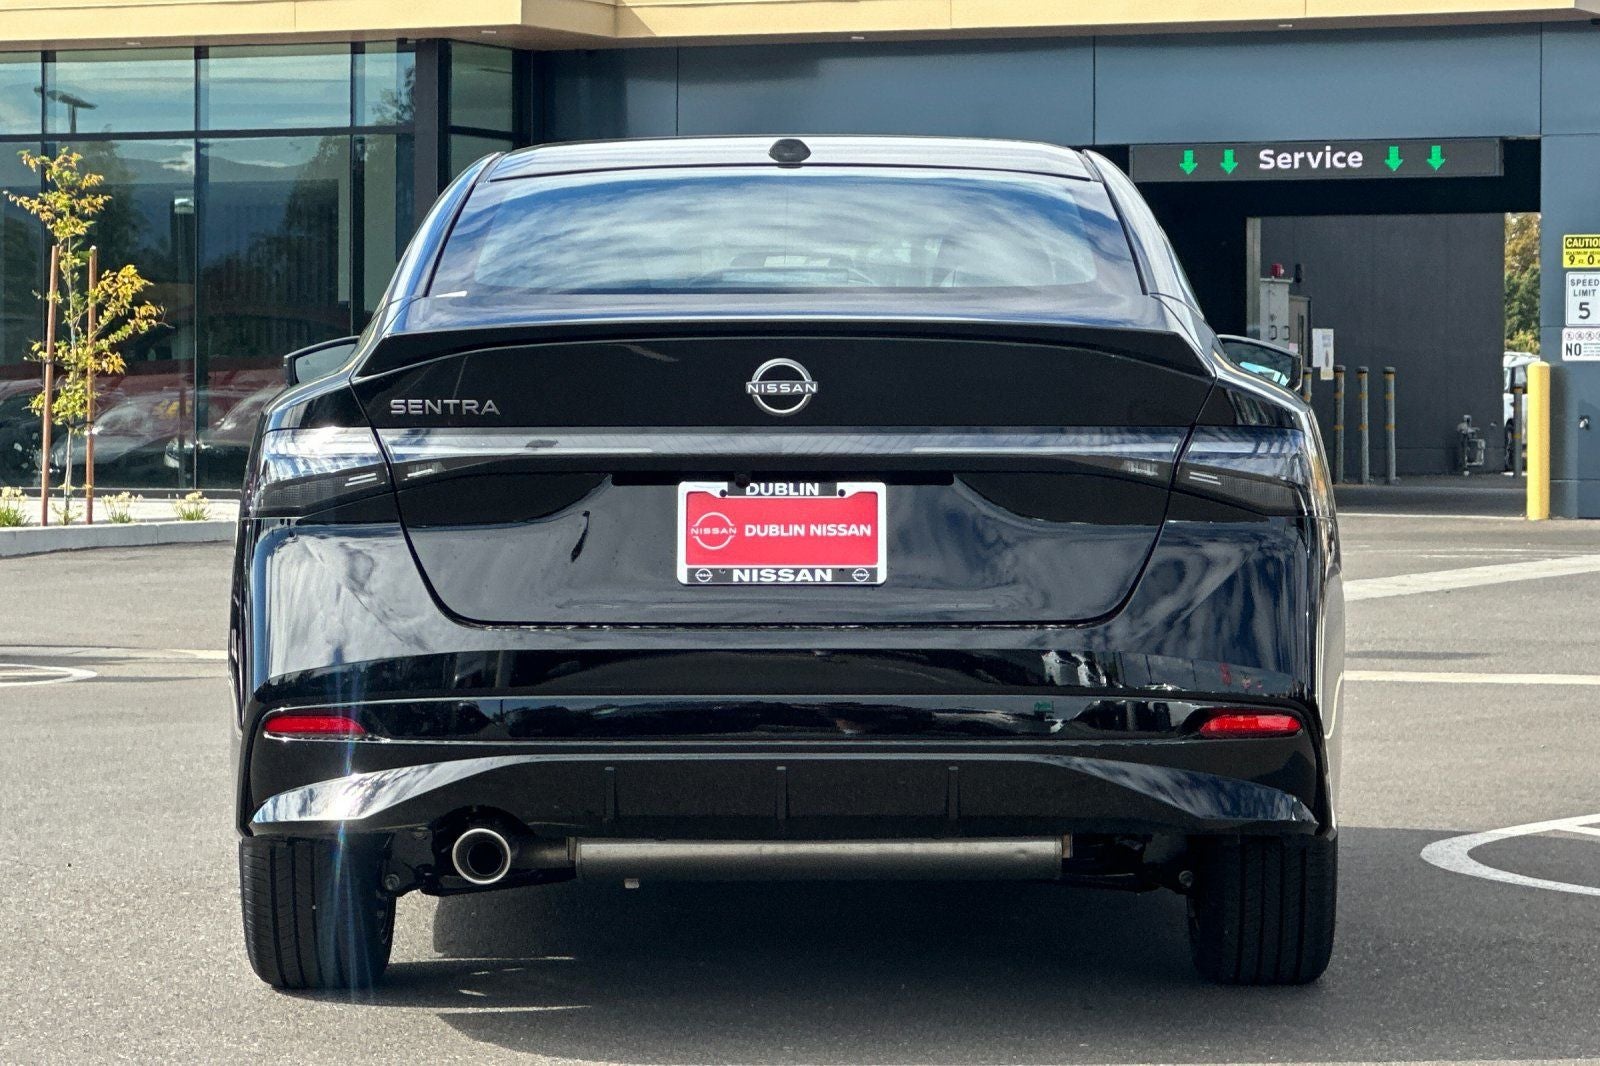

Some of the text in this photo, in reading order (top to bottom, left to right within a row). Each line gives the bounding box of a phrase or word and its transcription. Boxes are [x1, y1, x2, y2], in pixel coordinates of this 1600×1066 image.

[1258, 145, 1363, 170] Service
[1566, 238, 1600, 248] CAUTIO
[1570, 278, 1599, 287] SPEED
[1573, 289, 1596, 297] LIMIT
[1578, 301, 1591, 319] 5
[1565, 342, 1582, 357] NO
[747, 383, 817, 393] NISSAN
[390, 399, 500, 415] SENTRA
[745, 482, 819, 496] DUBLIN
[690, 526, 737, 534] NISSAN
[744, 524, 871, 537] DUBLIN NISSAN
[732, 568, 833, 582] NISSAN
